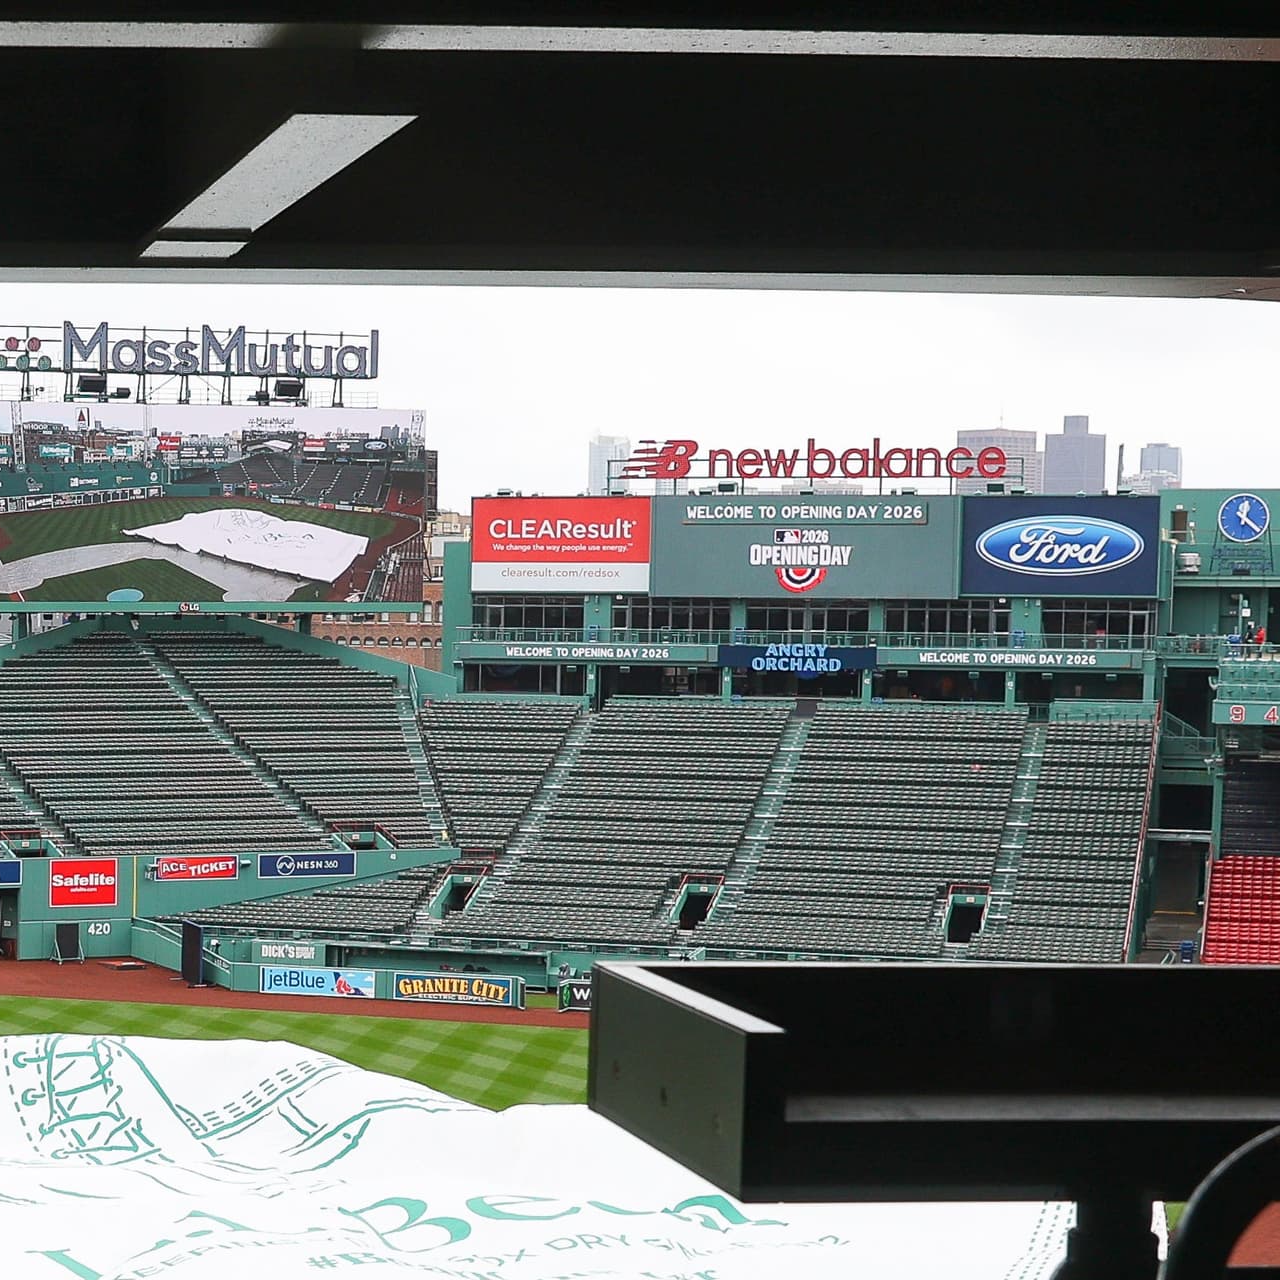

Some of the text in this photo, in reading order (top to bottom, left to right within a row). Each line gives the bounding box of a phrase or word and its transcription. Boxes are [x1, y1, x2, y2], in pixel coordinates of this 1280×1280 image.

[64, 321, 379, 380] MassMutual
[807, 438, 1007, 479] balance
[686, 505, 922, 519] WELCOME TO OPENING DAY 2026
[489, 518, 633, 539] CLEAResult
[802, 530, 829, 543] 2026
[493, 543, 505, 551] We
[506, 543, 531, 552] change
[533, 543, 545, 551] the
[546, 544, 560, 552] way
[561, 543, 586, 552] people
[1009, 525, 1111, 564] Ford
[501, 568, 620, 578] clearesult.com/redsox
[189, 603, 199, 611] LG
[506, 647, 669, 659] WELCOME TO OPENING DAY 2026
[765, 643, 828, 657] ANGRY
[751, 657, 842, 672] ORCHARD
[919, 652, 1097, 665] WELCOME TO OPENING DAY 2026
[1230, 706, 1279, 723] 9 4
[161, 859, 235, 876] ACE TICKET
[296, 859, 338, 869] NESN 360
[52, 873, 115, 887] Safelite
[87, 922, 111, 935] 420
[261, 944, 295, 959] DICK'S
[267, 971, 325, 990] jetBlue
[398, 978, 508, 1002] GRANITE CITY
[543, 1232, 632, 1252] DRY
